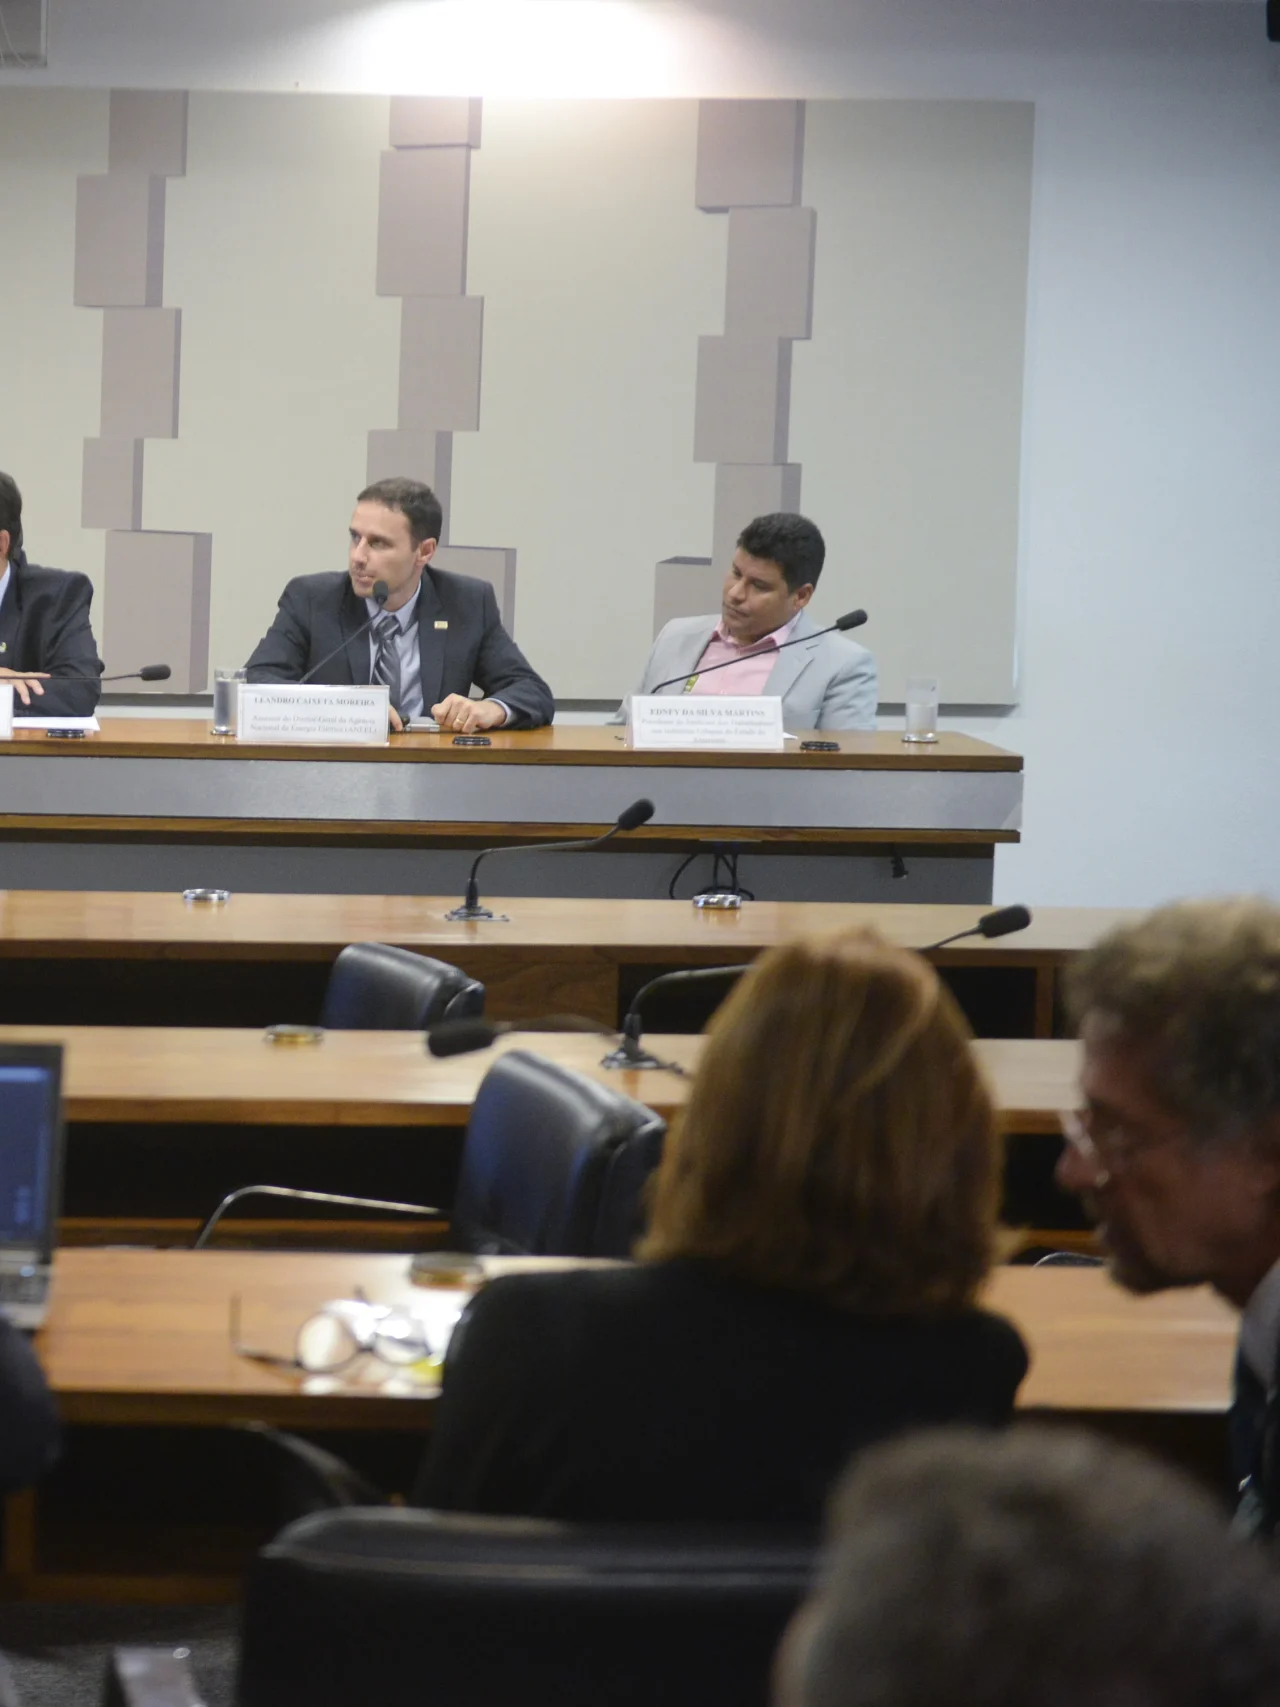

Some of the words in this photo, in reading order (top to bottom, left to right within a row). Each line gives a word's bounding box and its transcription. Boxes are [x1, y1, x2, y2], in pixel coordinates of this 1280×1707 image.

[296, 697, 334, 705] CAIXETA
[336, 698, 376, 706] MOREIRA
[650, 708, 680, 716] EDNEY
[724, 709, 766, 717] MARTINS
